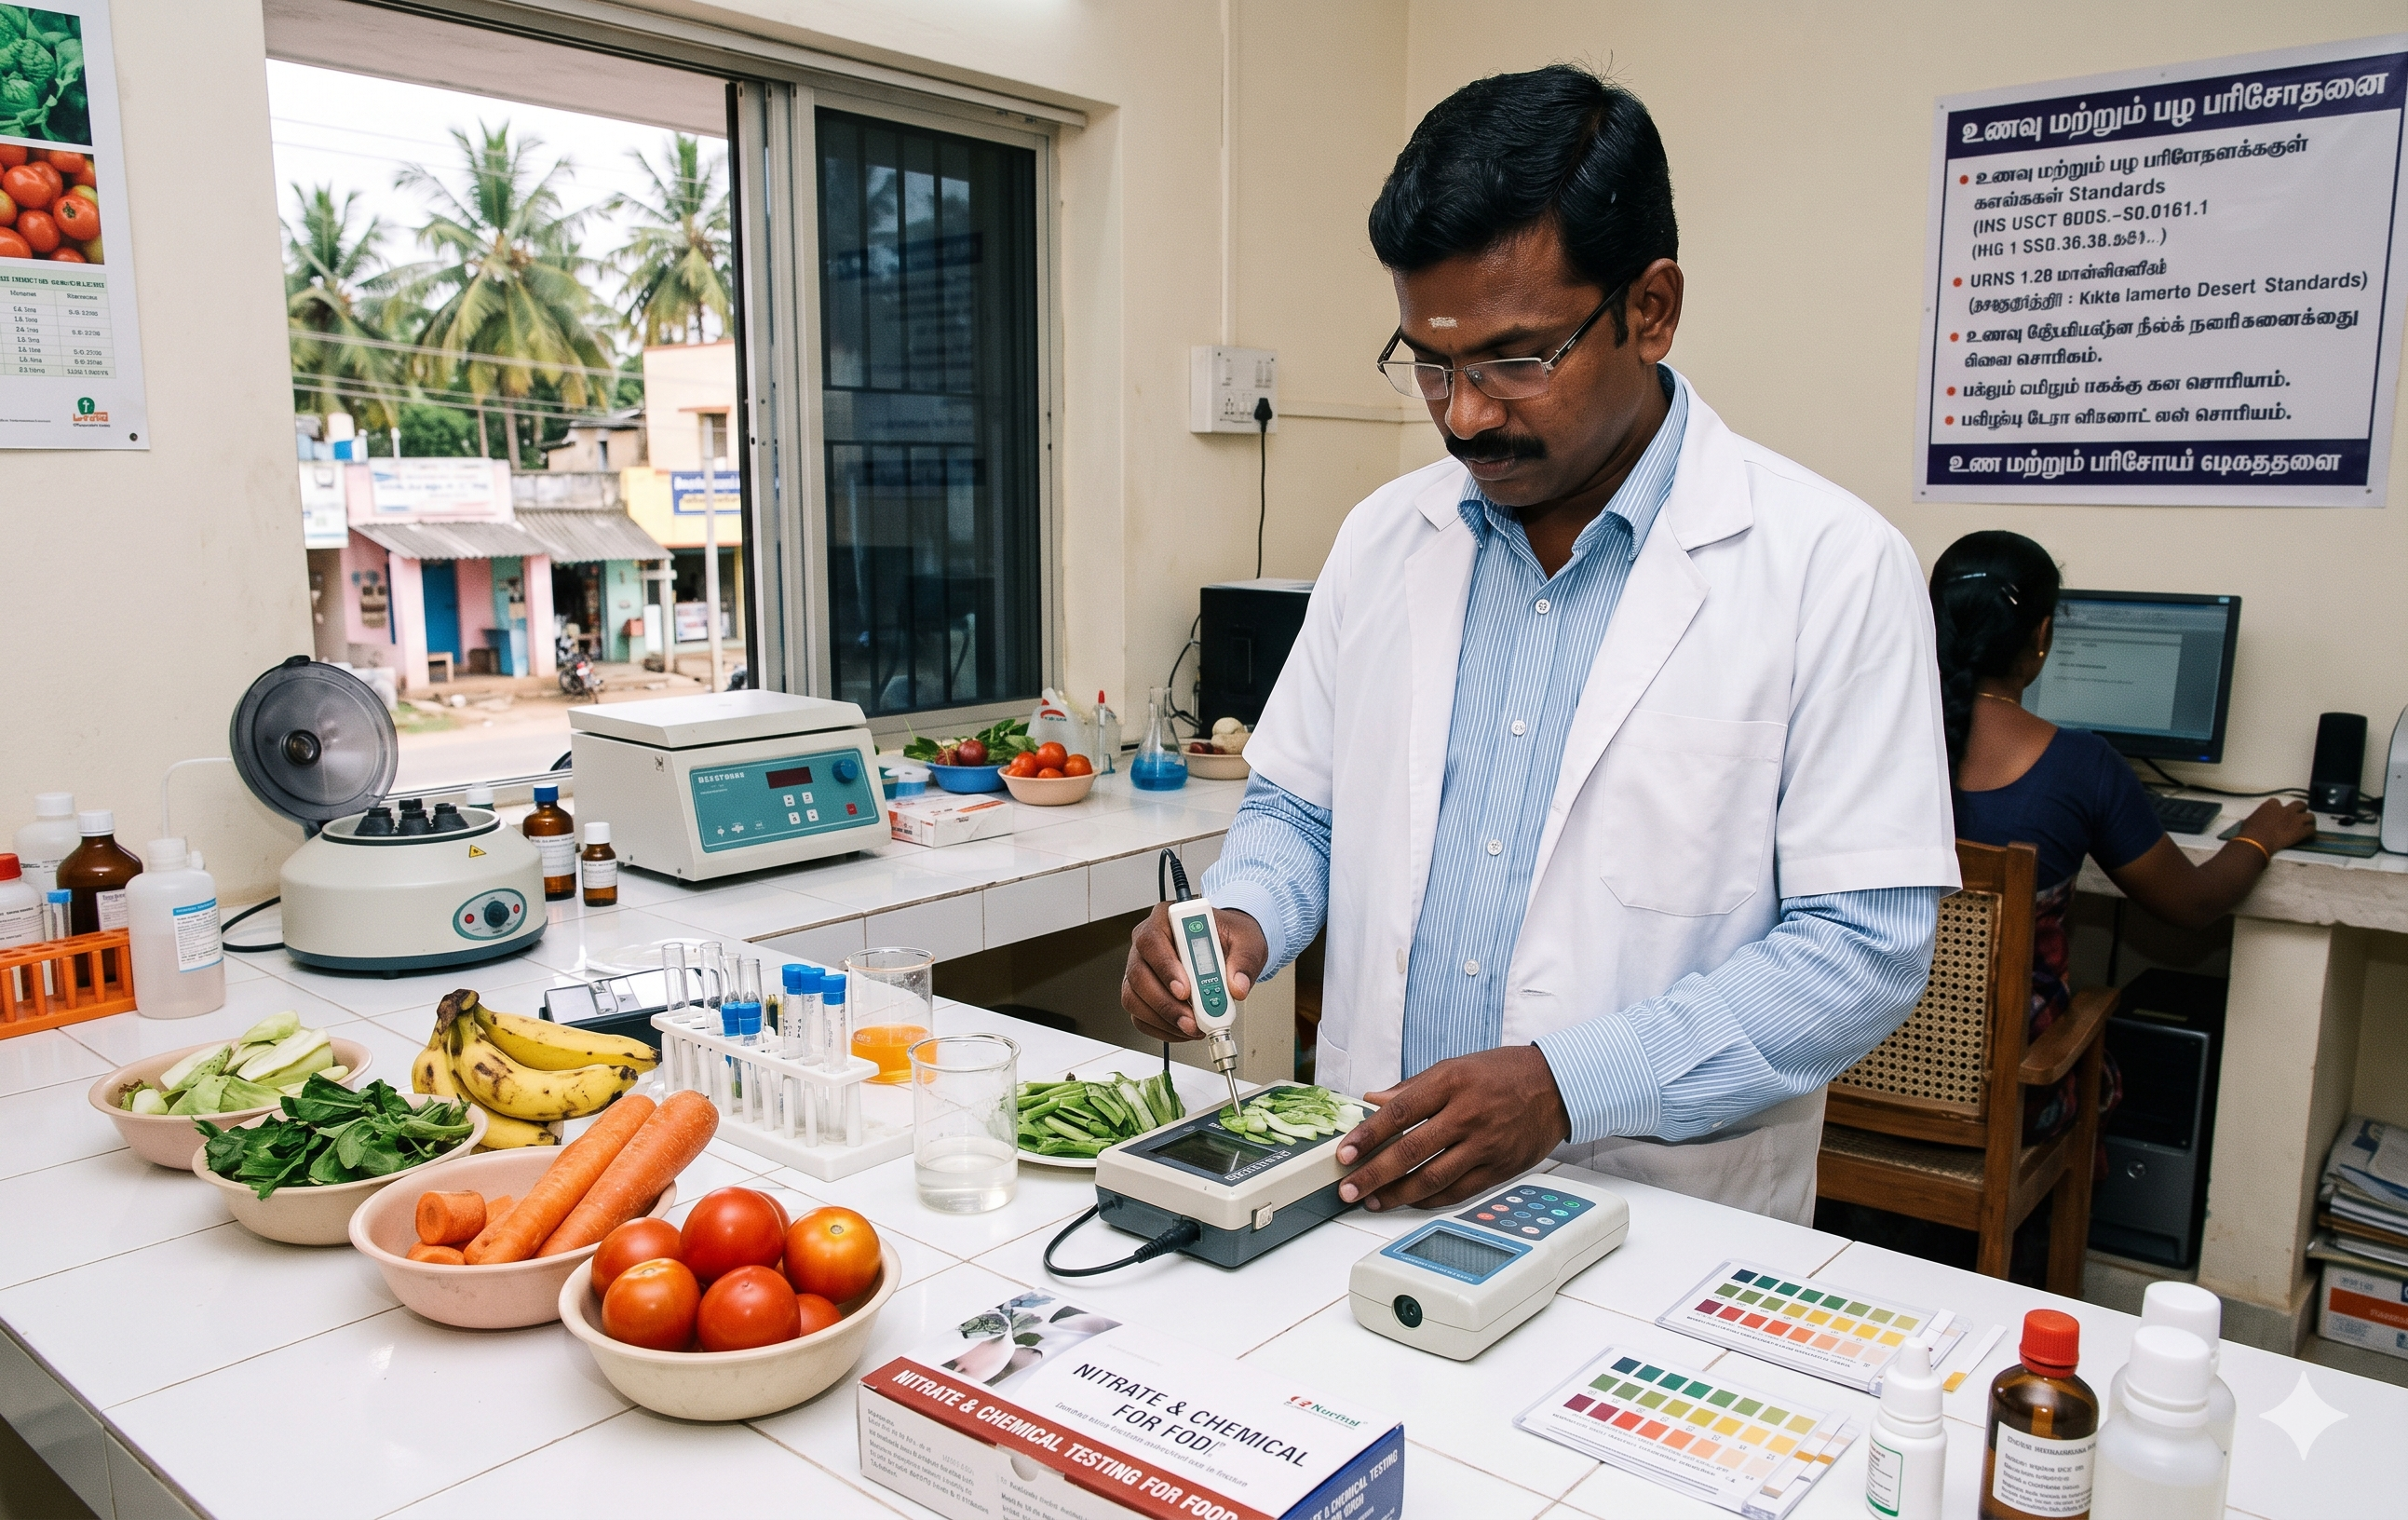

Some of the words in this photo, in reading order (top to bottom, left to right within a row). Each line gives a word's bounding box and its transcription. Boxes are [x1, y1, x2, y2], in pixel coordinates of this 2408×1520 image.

[1962, 116, 2043, 144] உணவு
[2049, 95, 2147, 140] மற்றும்
[2153, 97, 2196, 128] பழ
[2203, 73, 2389, 113] பரிசோதனை
[2037, 155, 2106, 183] மற்றும்
[2069, 177, 2167, 202] Standards
[1973, 218, 2007, 238] (INS
[2012, 212, 2059, 231] USCT
[1970, 271, 2016, 289] URNS
[2197, 278, 2257, 297] Desert
[2264, 270, 2369, 293] Standards)
[2006, 448, 2085, 479] மற்றும்
[1072, 1363, 1170, 1407] NITRATE
[1166, 1400, 1187, 1417] &
[1189, 1410, 1308, 1468] CHEMICAL
[1111, 1404, 1163, 1432] FOR
[891, 1369, 967, 1407] NITRATE
[958, 1398, 980, 1414] &
[975, 1405, 1064, 1453] CHEMICAL
[1063, 1442, 1143, 1486] TESTING
[1138, 1475, 1184, 1505] FOR
